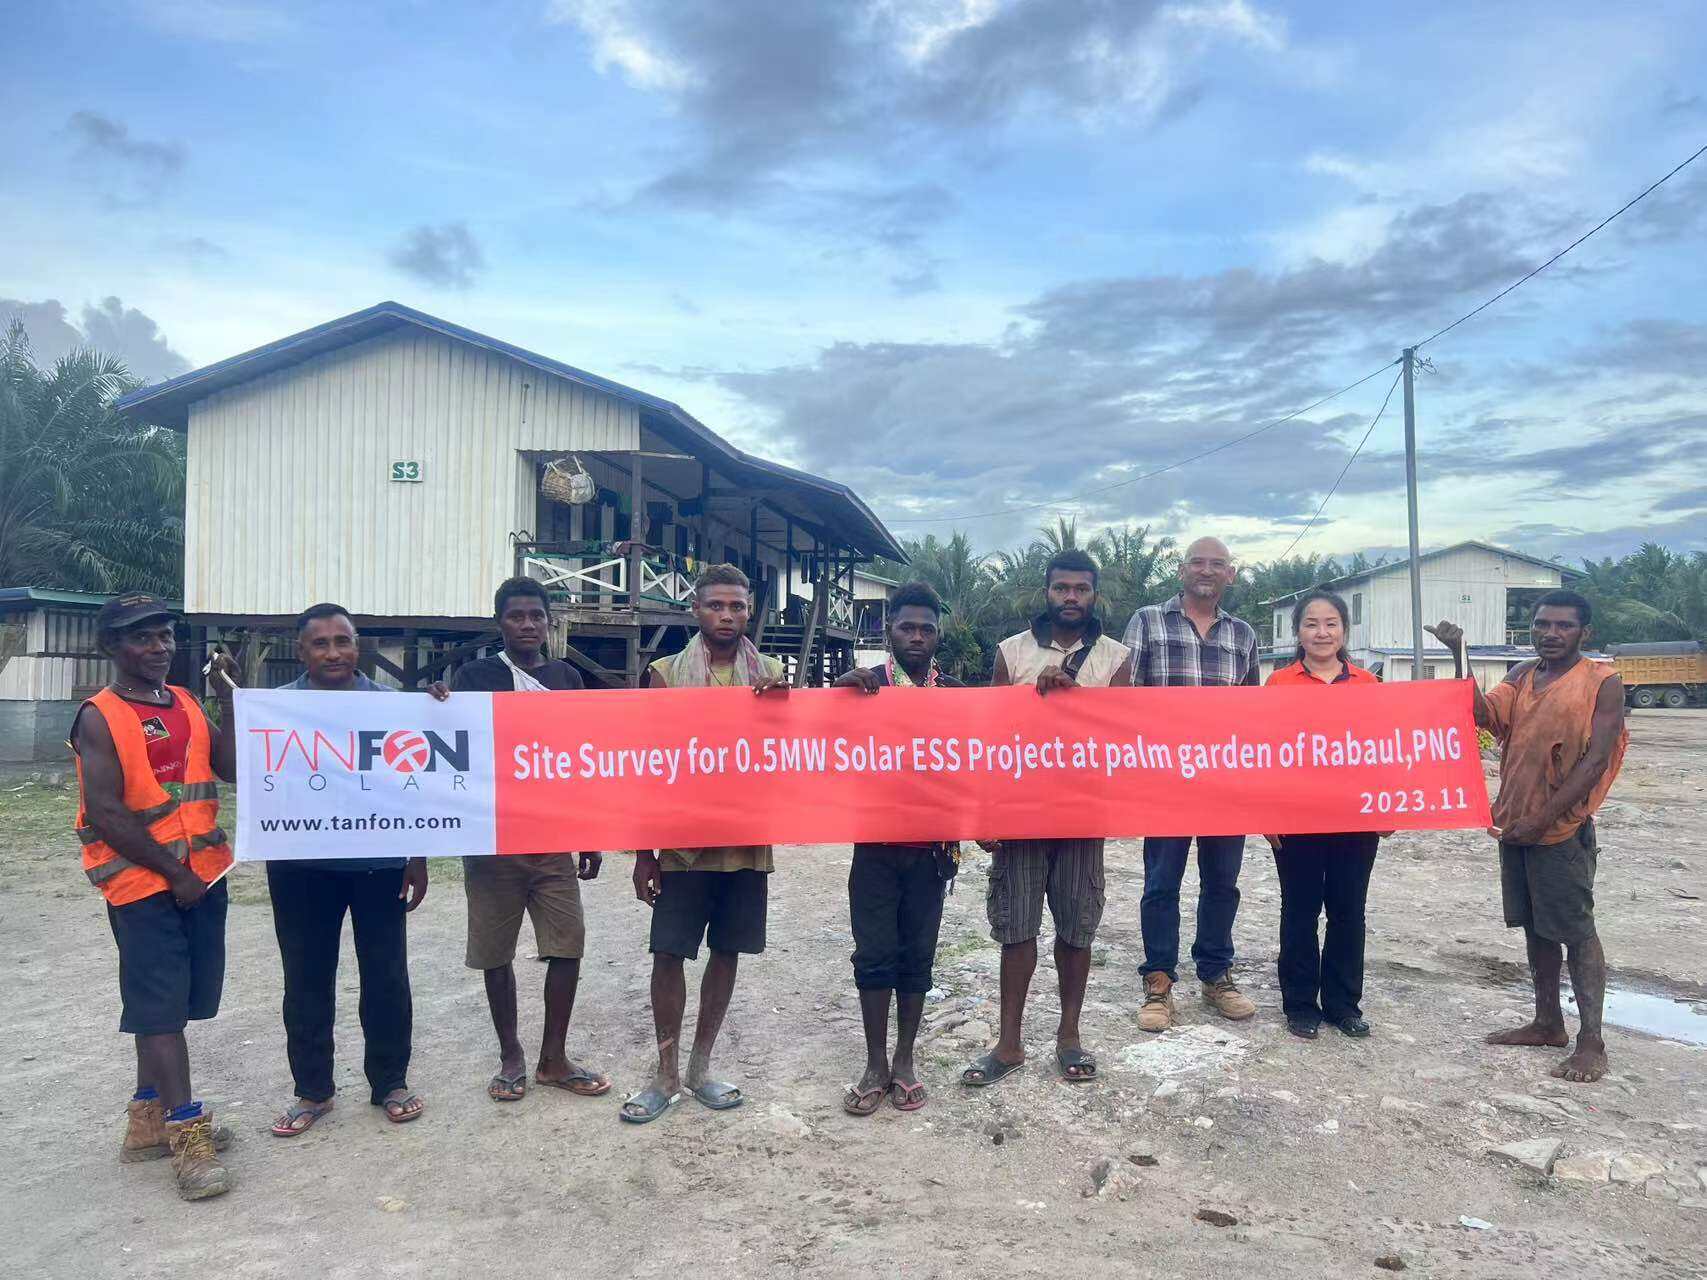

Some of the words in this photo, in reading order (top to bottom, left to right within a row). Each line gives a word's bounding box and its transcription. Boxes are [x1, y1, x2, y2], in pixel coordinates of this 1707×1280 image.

[392, 461, 419, 479] S3
[249, 729, 470, 772] TANFON
[513, 741, 572, 780] Site
[579, 742, 681, 785] Survey
[687, 736, 729, 774] for
[735, 737, 827, 773] 0.5MW
[833, 736, 906, 772] Solar
[912, 737, 961, 772] ESS
[968, 735, 1066, 779] Project
[1072, 737, 1099, 769] at
[1105, 735, 1173, 777] palm
[1177, 734, 1272, 779] garden
[1279, 732, 1306, 768] of
[1312, 727, 1463, 771] Rabaul,PNG
[263, 774, 467, 792] SOLAR
[1359, 787, 1468, 814] 2023.11
[260, 813, 462, 833] www.tanfon.com
